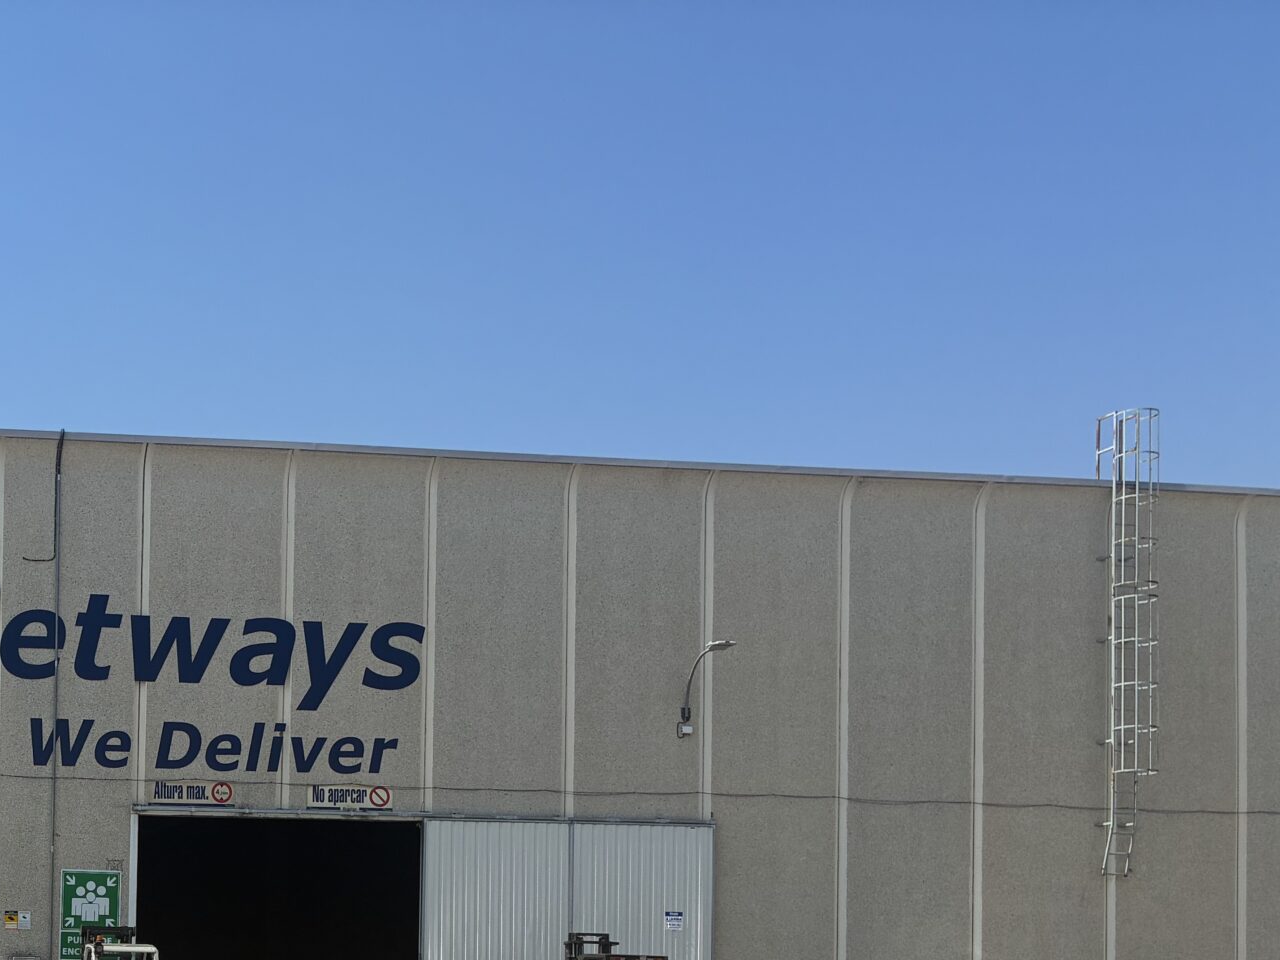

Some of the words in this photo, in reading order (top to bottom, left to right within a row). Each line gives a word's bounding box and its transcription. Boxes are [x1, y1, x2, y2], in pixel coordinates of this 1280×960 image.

[30, 718, 132, 767] We
[155, 721, 398, 773] Deliver
[154, 781, 183, 800] Altura
[186, 786, 209, 801] max.
[312, 785, 325, 803] No
[327, 786, 367, 807] aparcar
